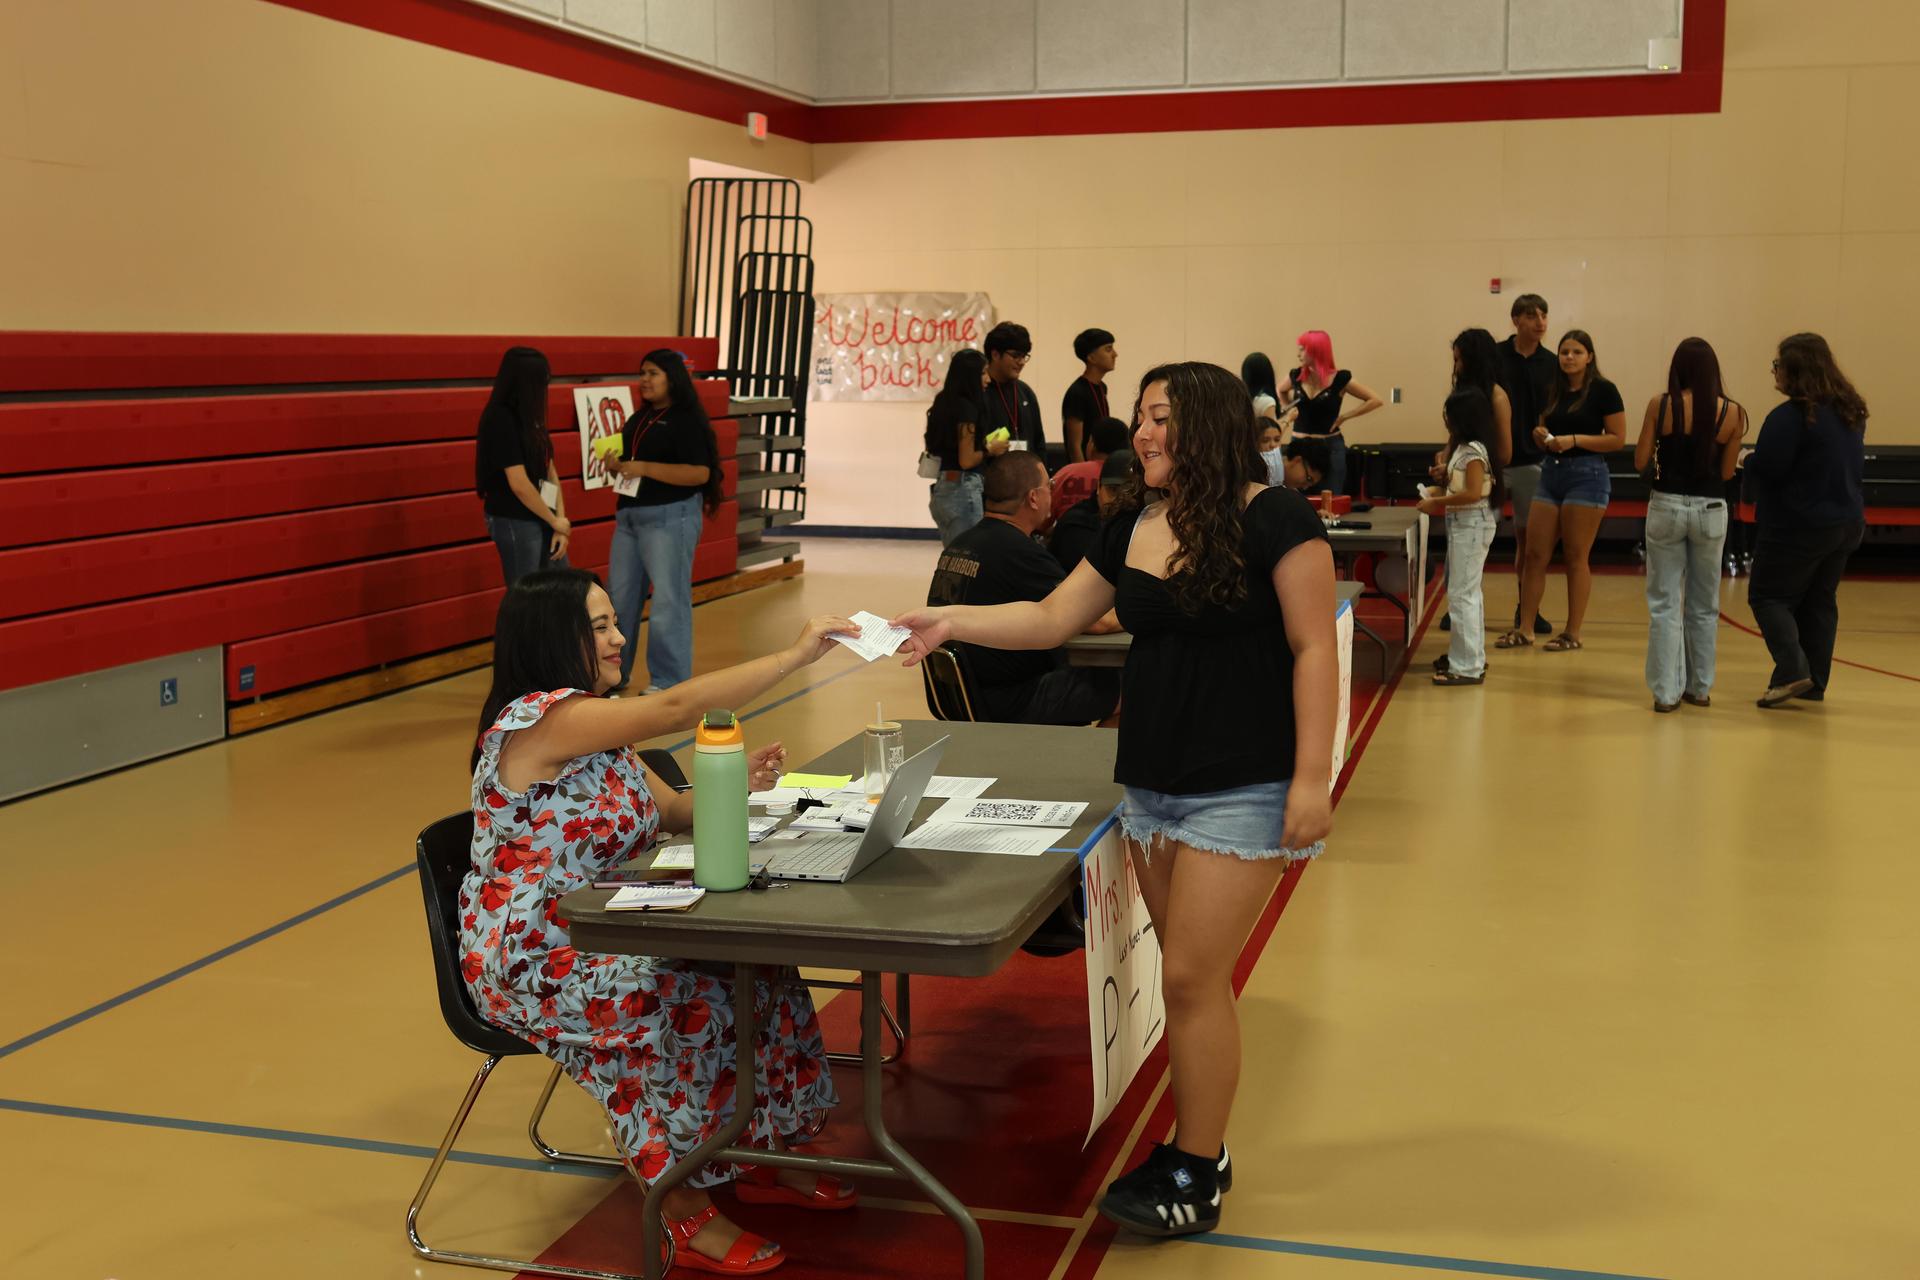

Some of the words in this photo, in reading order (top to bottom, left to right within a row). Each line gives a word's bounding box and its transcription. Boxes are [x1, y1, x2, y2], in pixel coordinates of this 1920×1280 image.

[817, 304, 979, 347] Welcome
[853, 350, 941, 392] back
[1086, 854, 1123, 953] Mrs.
[1118, 939, 1128, 964] Last
[1102, 975, 1120, 1098] P
